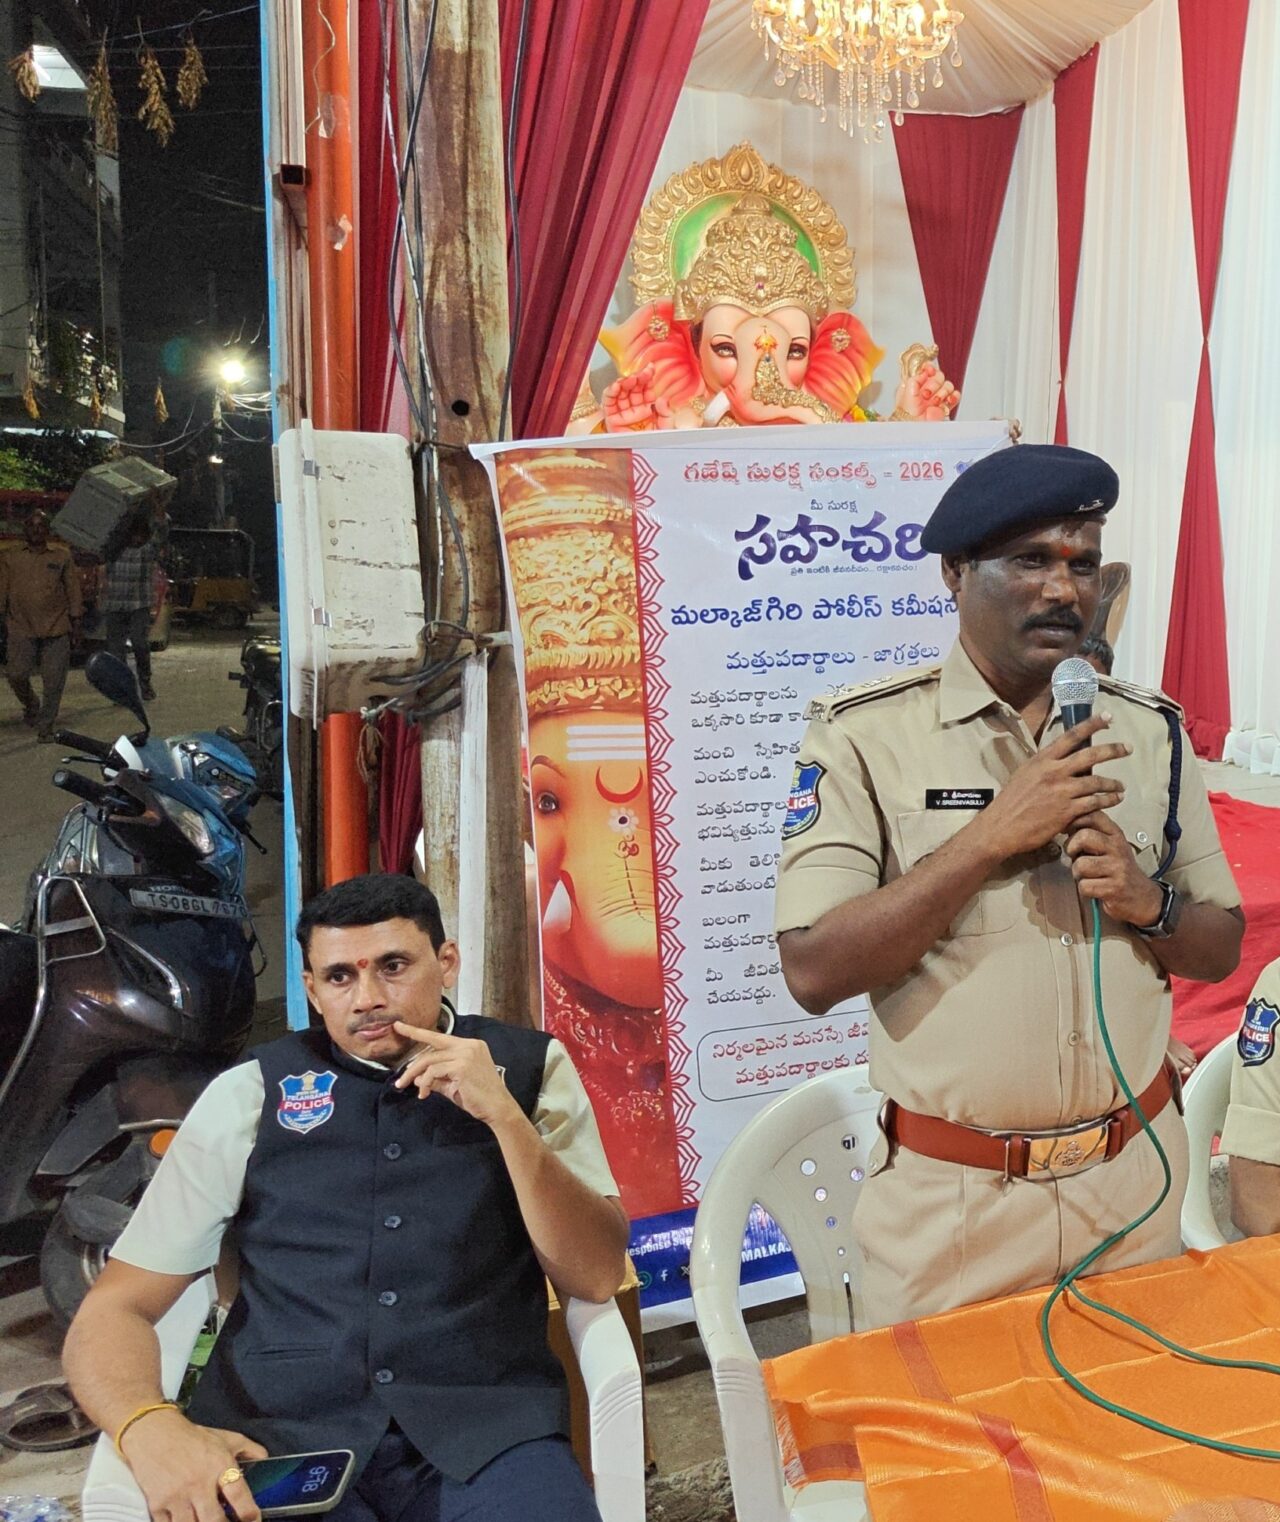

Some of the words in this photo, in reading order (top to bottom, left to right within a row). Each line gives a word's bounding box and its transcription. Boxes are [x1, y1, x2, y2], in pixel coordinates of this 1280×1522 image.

[684, 460, 739, 485] గణేష్
[747, 461, 803, 490] సురక్ష
[809, 460, 877, 488] సంకల్ప్
[899, 461, 944, 481] 2026
[811, 499, 823, 510] మీ
[828, 500, 858, 513] సురక్ష
[812, 594, 883, 620] పోలీస్
[891, 593, 959, 618] కమీషన
[750, 712, 783, 725] కూడా
[693, 747, 735, 761] మంచి
[754, 740, 801, 760] స్నేహిత
[696, 800, 788, 819] మత్తుపదార్థాల
[787, 795, 816, 809] LICE
[700, 857, 733, 872] మీకు
[702, 913, 751, 927] బలంగా
[705, 968, 723, 983] మీ
[743, 961, 784, 978] జీవిత
[284, 1096, 331, 1110] POLICE
[626, 1241, 671, 1257] esponse
